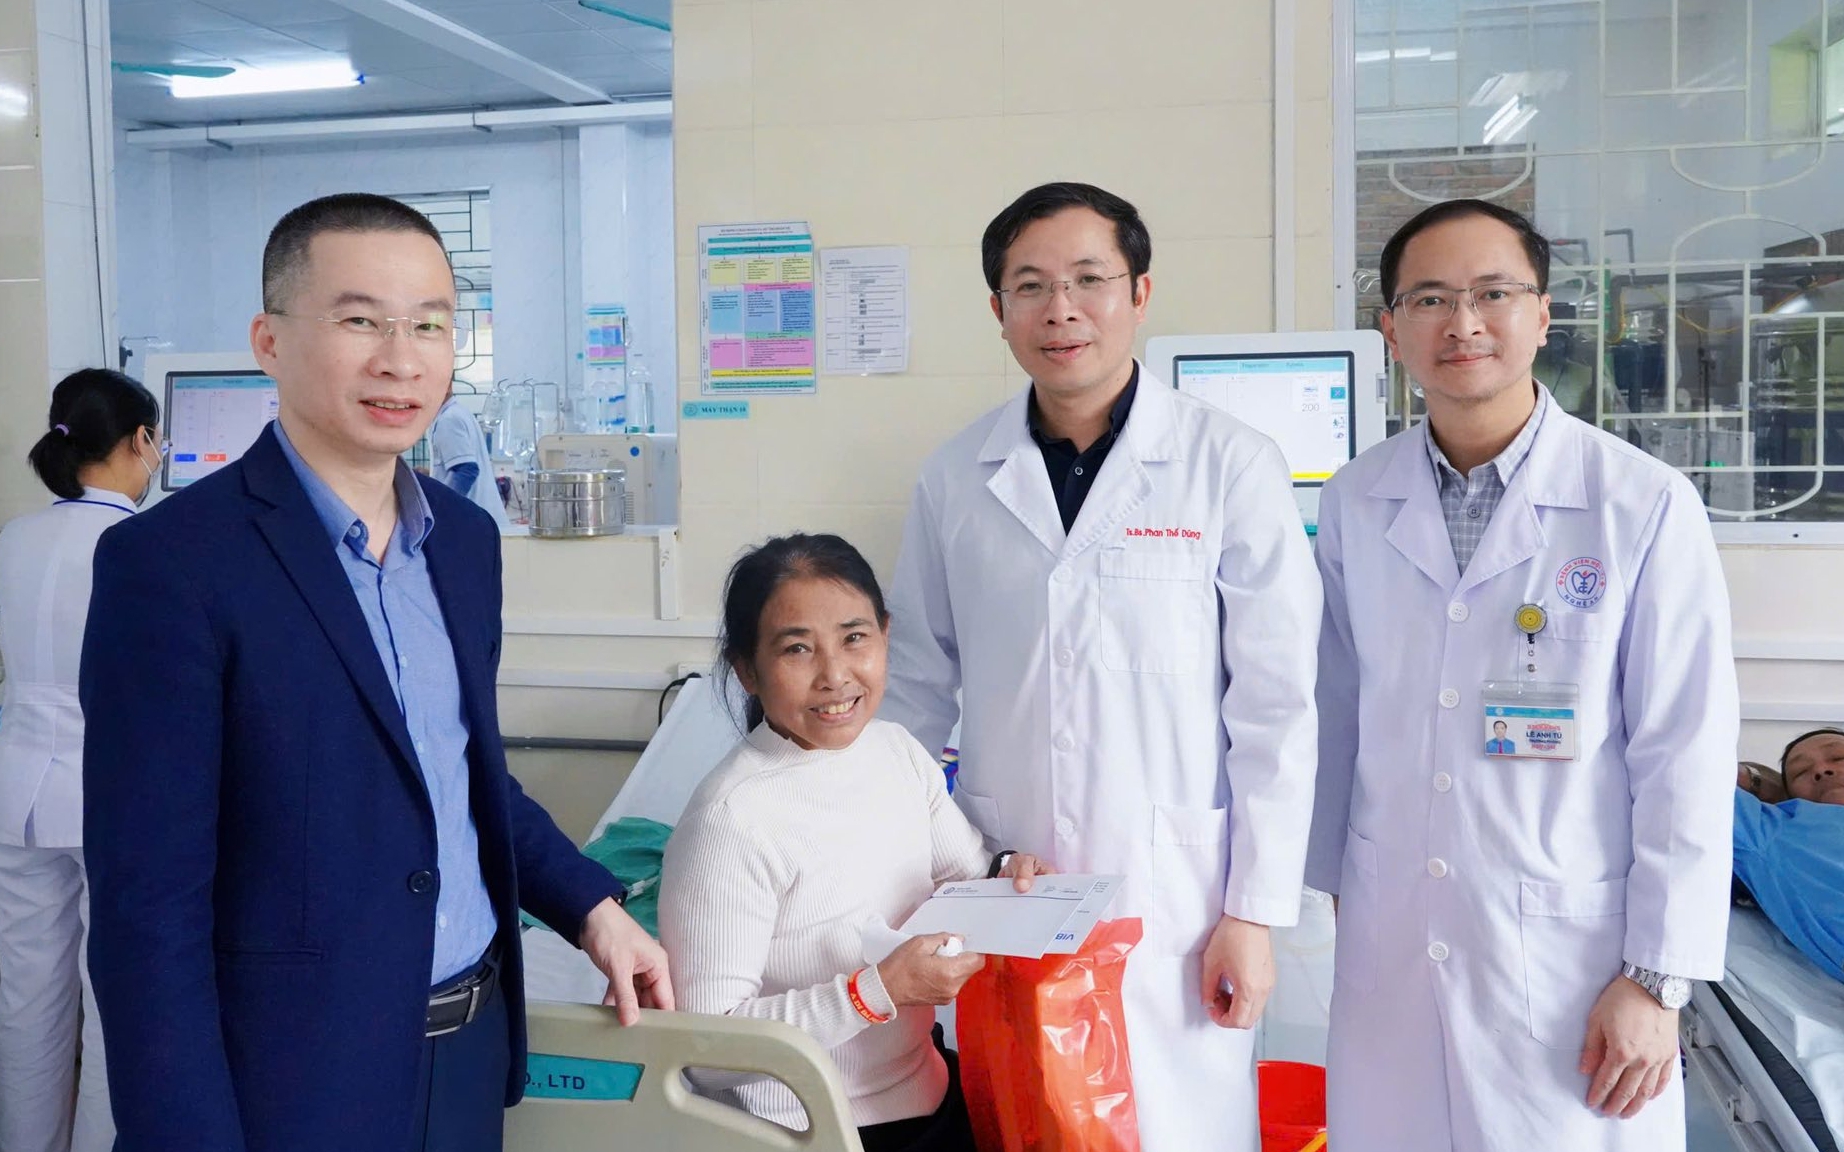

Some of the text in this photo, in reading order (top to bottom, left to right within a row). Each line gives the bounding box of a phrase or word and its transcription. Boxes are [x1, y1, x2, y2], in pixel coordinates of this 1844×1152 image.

[1302, 403, 1320, 412] 200
[1526, 730, 1536, 738] LÊ
[1055, 933, 1074, 941] VIB
[548, 1074, 585, 1090] LTD
